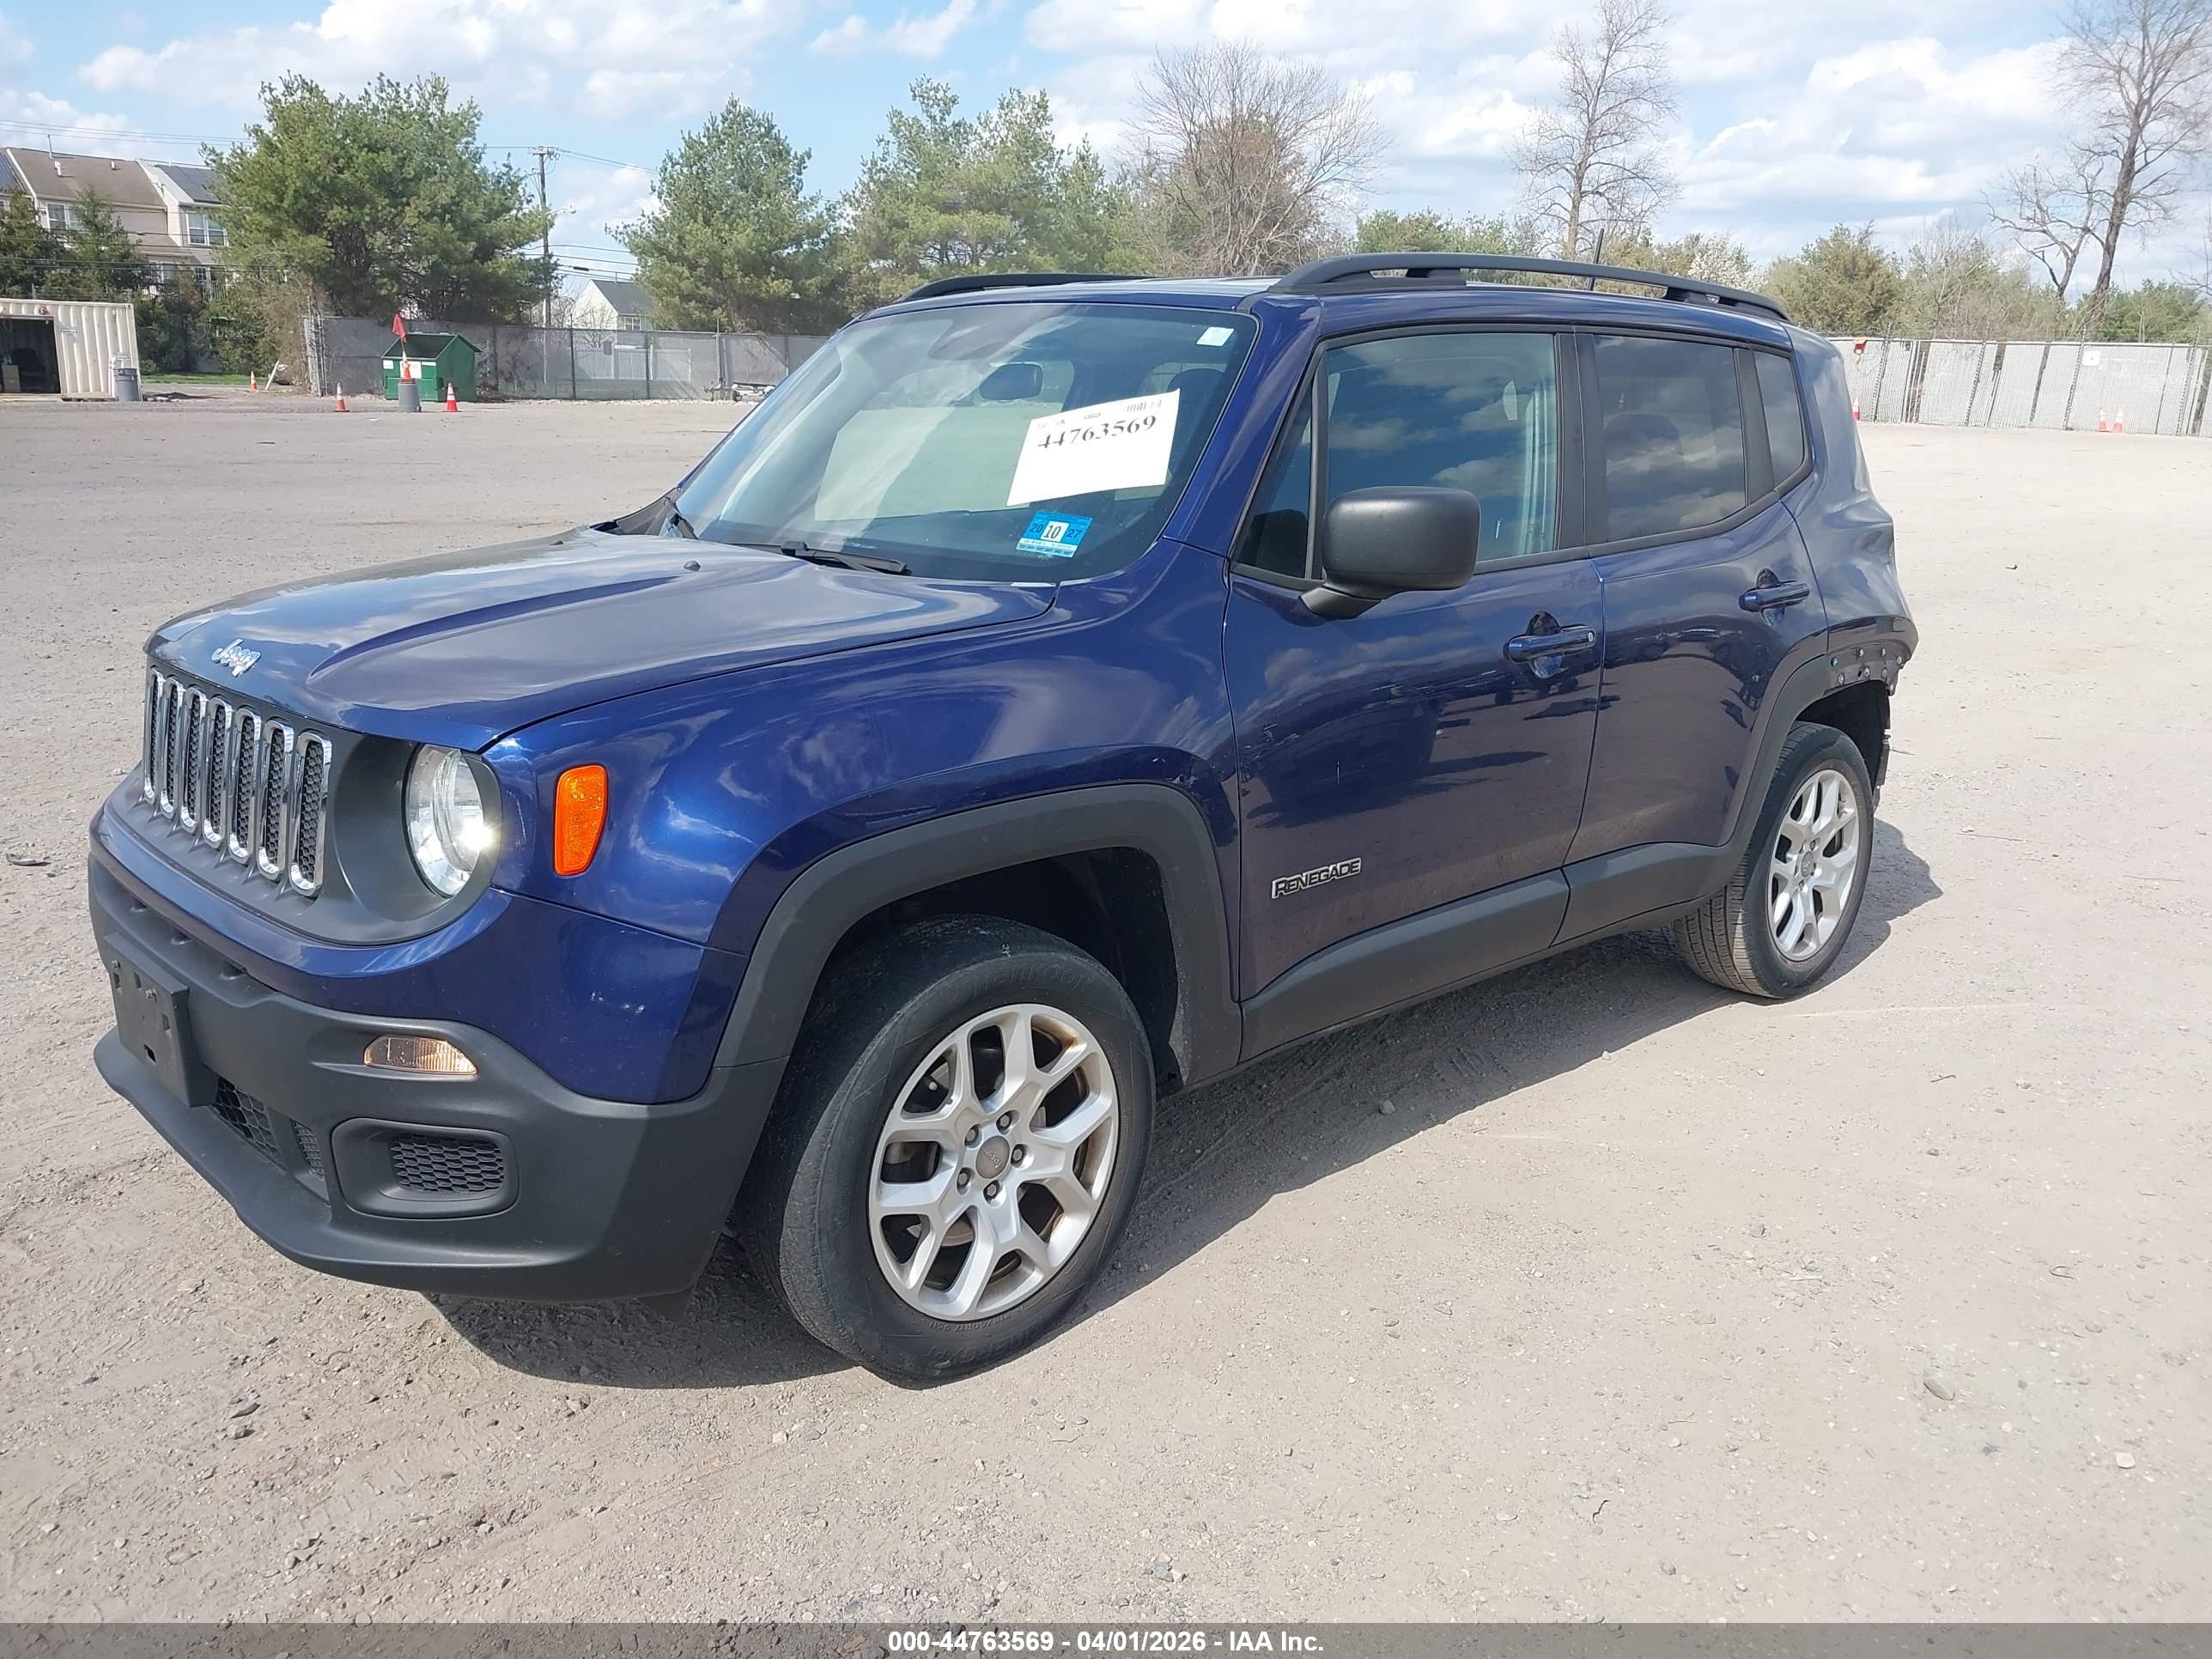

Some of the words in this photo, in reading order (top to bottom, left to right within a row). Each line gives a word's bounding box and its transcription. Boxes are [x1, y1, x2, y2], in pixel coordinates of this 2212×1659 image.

[1038, 415, 1157, 448] 44763569
[1030, 523, 1044, 533] 20
[1043, 525, 1061, 539] 10
[1066, 528, 1082, 539] 27
[211, 638, 261, 678] Jeep
[1271, 857, 1362, 900] RENEGADE
